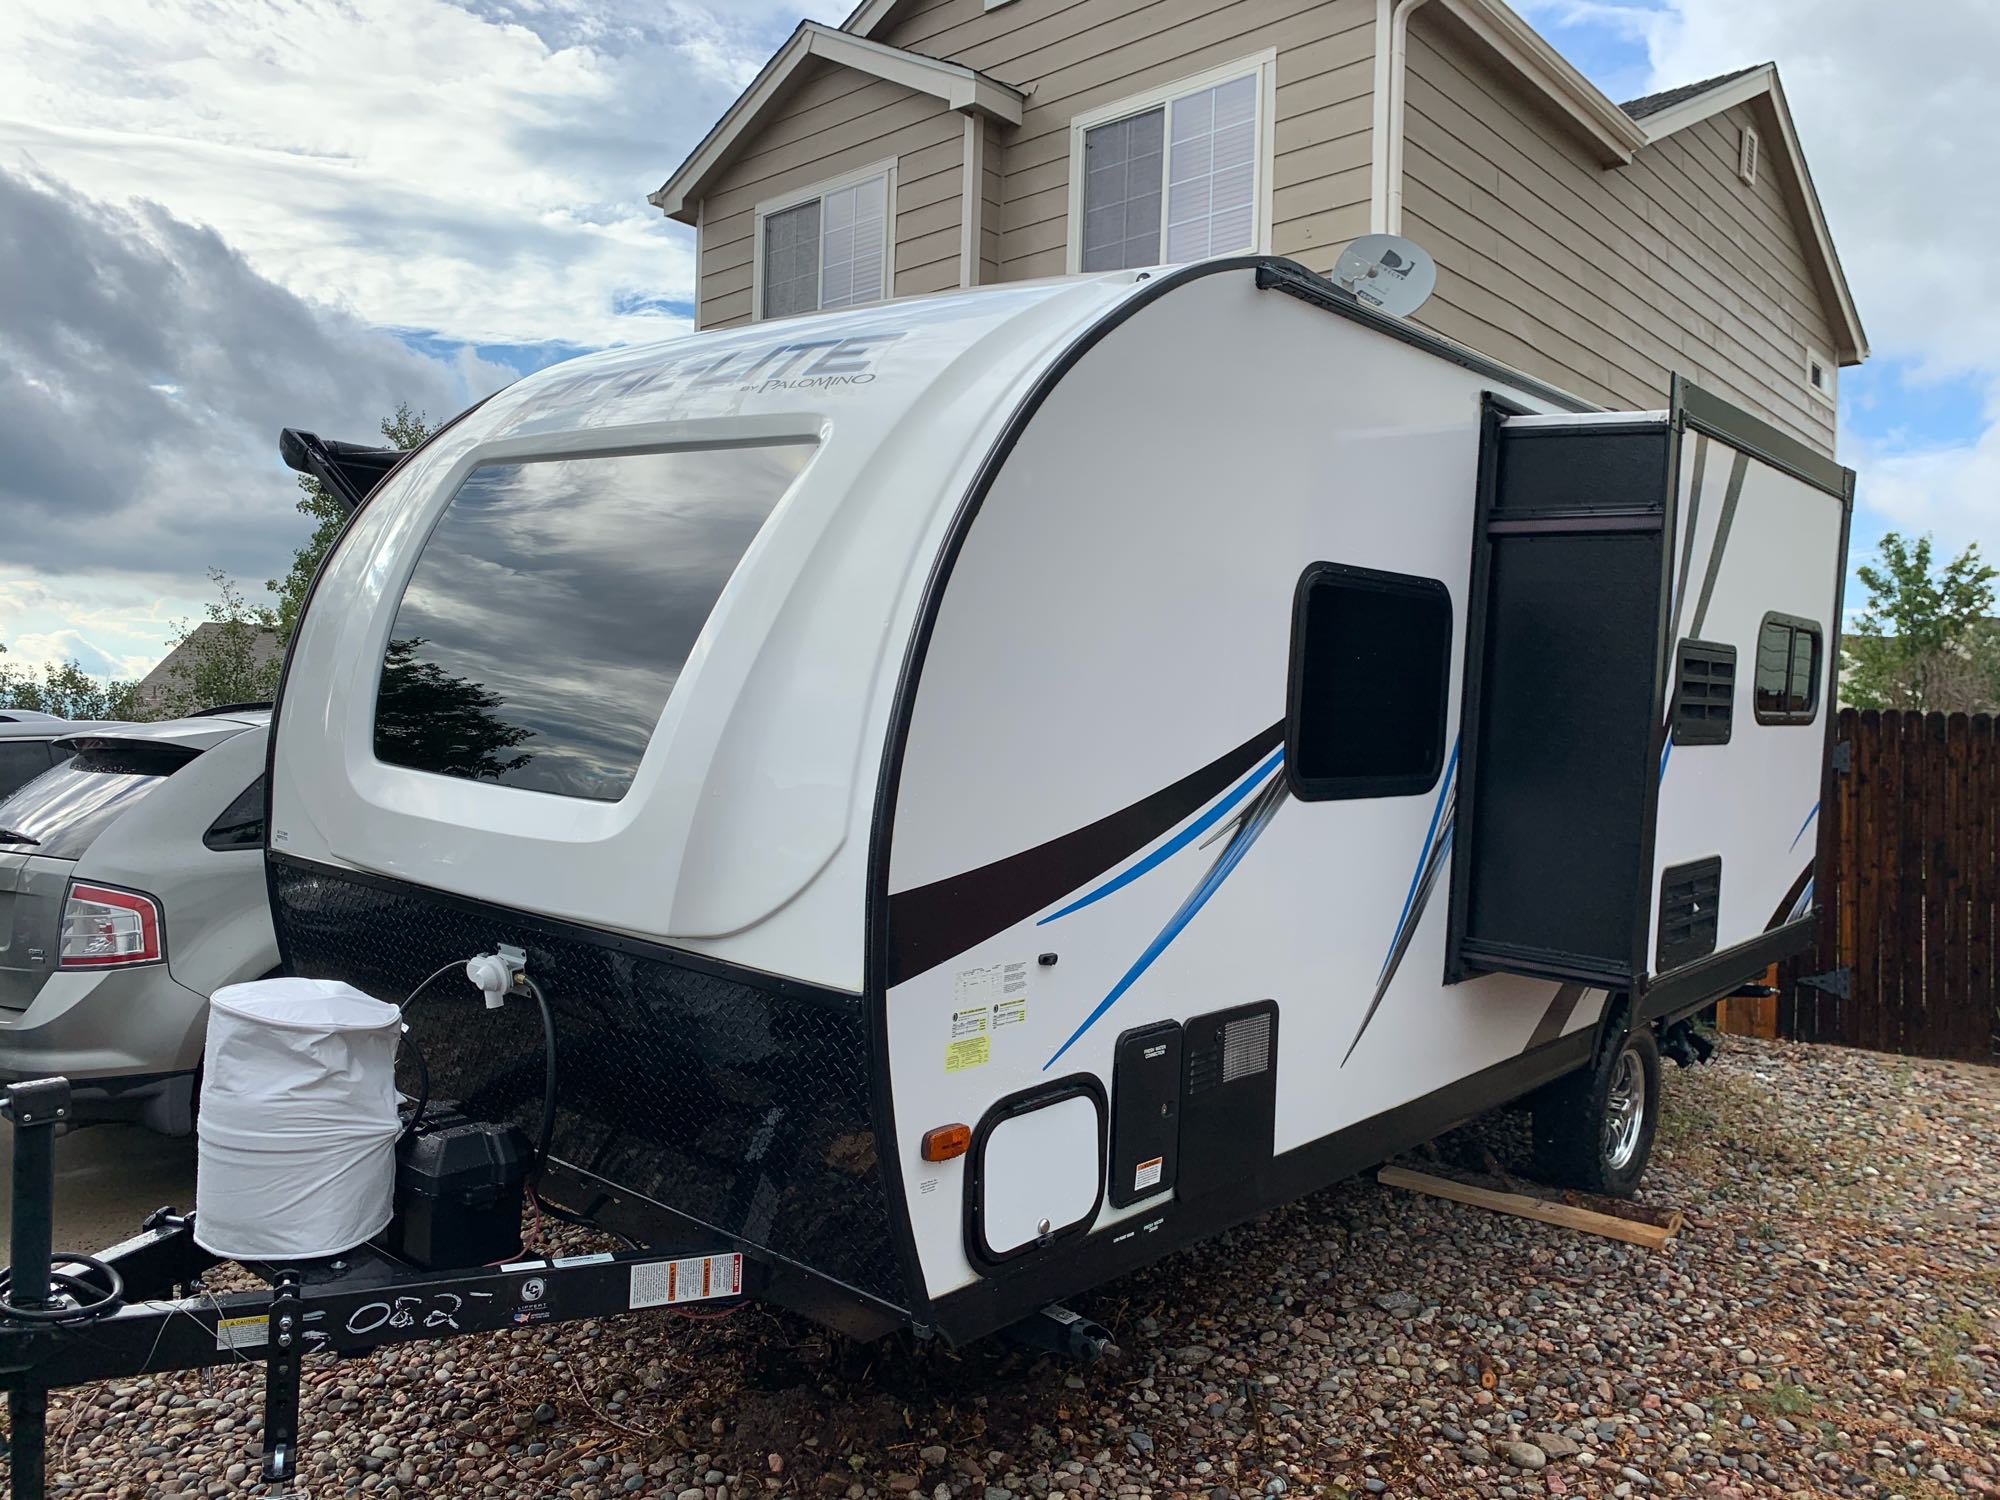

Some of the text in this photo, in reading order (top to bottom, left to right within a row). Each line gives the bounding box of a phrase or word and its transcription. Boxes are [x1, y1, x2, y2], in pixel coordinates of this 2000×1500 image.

[757, 373, 877, 394] PALOMINO
[517, 1302, 547, 1310] LIPPERT
[236, 1317, 261, 1326] CAUTION
